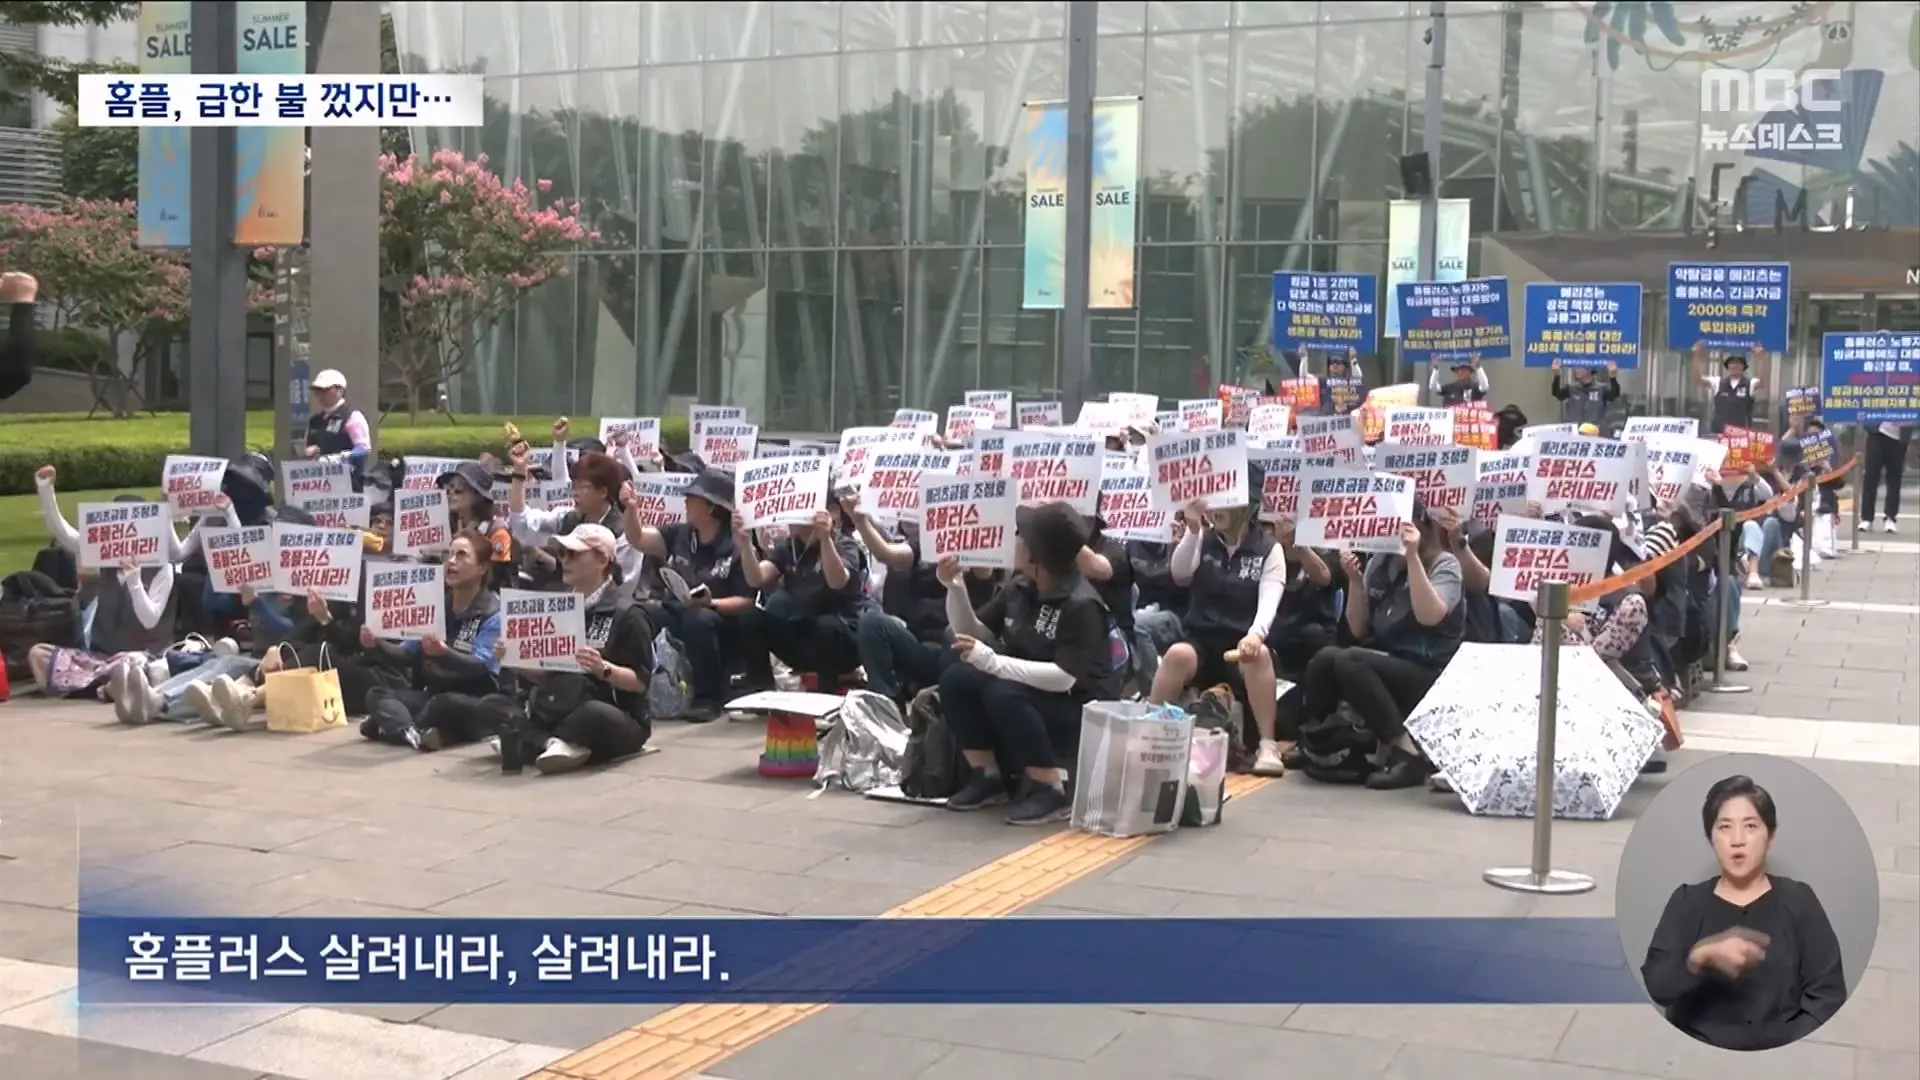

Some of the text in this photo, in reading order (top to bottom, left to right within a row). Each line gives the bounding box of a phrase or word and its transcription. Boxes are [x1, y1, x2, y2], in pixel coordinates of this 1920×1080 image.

[146, 34, 191, 58] SALE
[243, 25, 297, 52] SALE
[1030, 193, 1065, 208] SALE
[1095, 191, 1131, 207] SALE
[1391, 260, 1416, 271] SALE
[1438, 259, 1464, 271] SALE
[1729, 268, 1782, 282] 메리츠는
[1675, 285, 1781, 300] 홈플러스 긴급자금
[1597, 300, 1619, 312] 있는
[1688, 303, 1737, 316] 2000억
[1845, 336, 1887, 348] 홈플러스
[1390, 423, 1431, 438] 홈플러스
[704, 437, 739, 452] 홈플러스
[1012, 441, 1096, 457] 메리츠금융 조정호
[1154, 431, 1237, 461] 메리츠금융 조정호
[1539, 440, 1628, 459] 메리츠금융 조정호
[874, 454, 920, 468] 메리츠금융
[921, 454, 952, 468] 조정호
[979, 453, 1004, 472] 홈플
[1157, 453, 1213, 484] 홈플러스
[1384, 449, 1470, 468] 메리츠금융 조정호
[1536, 458, 1597, 479] 홈플러스
[743, 459, 821, 484] 메리츠금융 조정호
[1010, 459, 1068, 481] 홈플러스
[1417, 469, 1447, 489] 러스
[742, 476, 797, 504] 홈플러스
[924, 479, 1007, 505] 메리츠금융 조정호
[1020, 480, 1090, 501] 살려내라!
[1101, 476, 1144, 490] 메리츠금융
[1169, 470, 1238, 503] 살려내라!
[1311, 477, 1407, 494] 메리츠금융 조정호
[1545, 480, 1618, 502] 살려내라!
[754, 492, 818, 520] 살려내라!
[877, 488, 919, 510] 살려내
[1101, 491, 1150, 511] 홈플러스
[1308, 496, 1378, 518] 홈플러스
[400, 511, 430, 532] 홈플러스
[925, 504, 980, 533] 홈플러스
[1107, 509, 1166, 530] 살려내라!
[1323, 517, 1403, 540] 살려내라!
[87, 522, 138, 544] 홈플러스
[279, 532, 357, 547] 메리츠금융 조정호
[407, 525, 445, 548] 살려내라!
[934, 525, 1005, 555] 살려내라!
[1505, 528, 1602, 548] 메리츠금융 조정호
[100, 536, 159, 560] 살려내라!
[212, 547, 252, 570] 홈플러스
[279, 548, 330, 568] 홈플러스
[1502, 547, 1570, 569] 홈플러스
[224, 561, 273, 586] 살려내라!
[290, 568, 351, 587] 살려내라!
[372, 587, 416, 611] 홈플러스
[507, 596, 576, 615] 메리츠금융 조정호
[382, 604, 436, 630] 살려내라!
[507, 616, 556, 639] 홈플러스
[519, 635, 576, 660] 살려내라!
